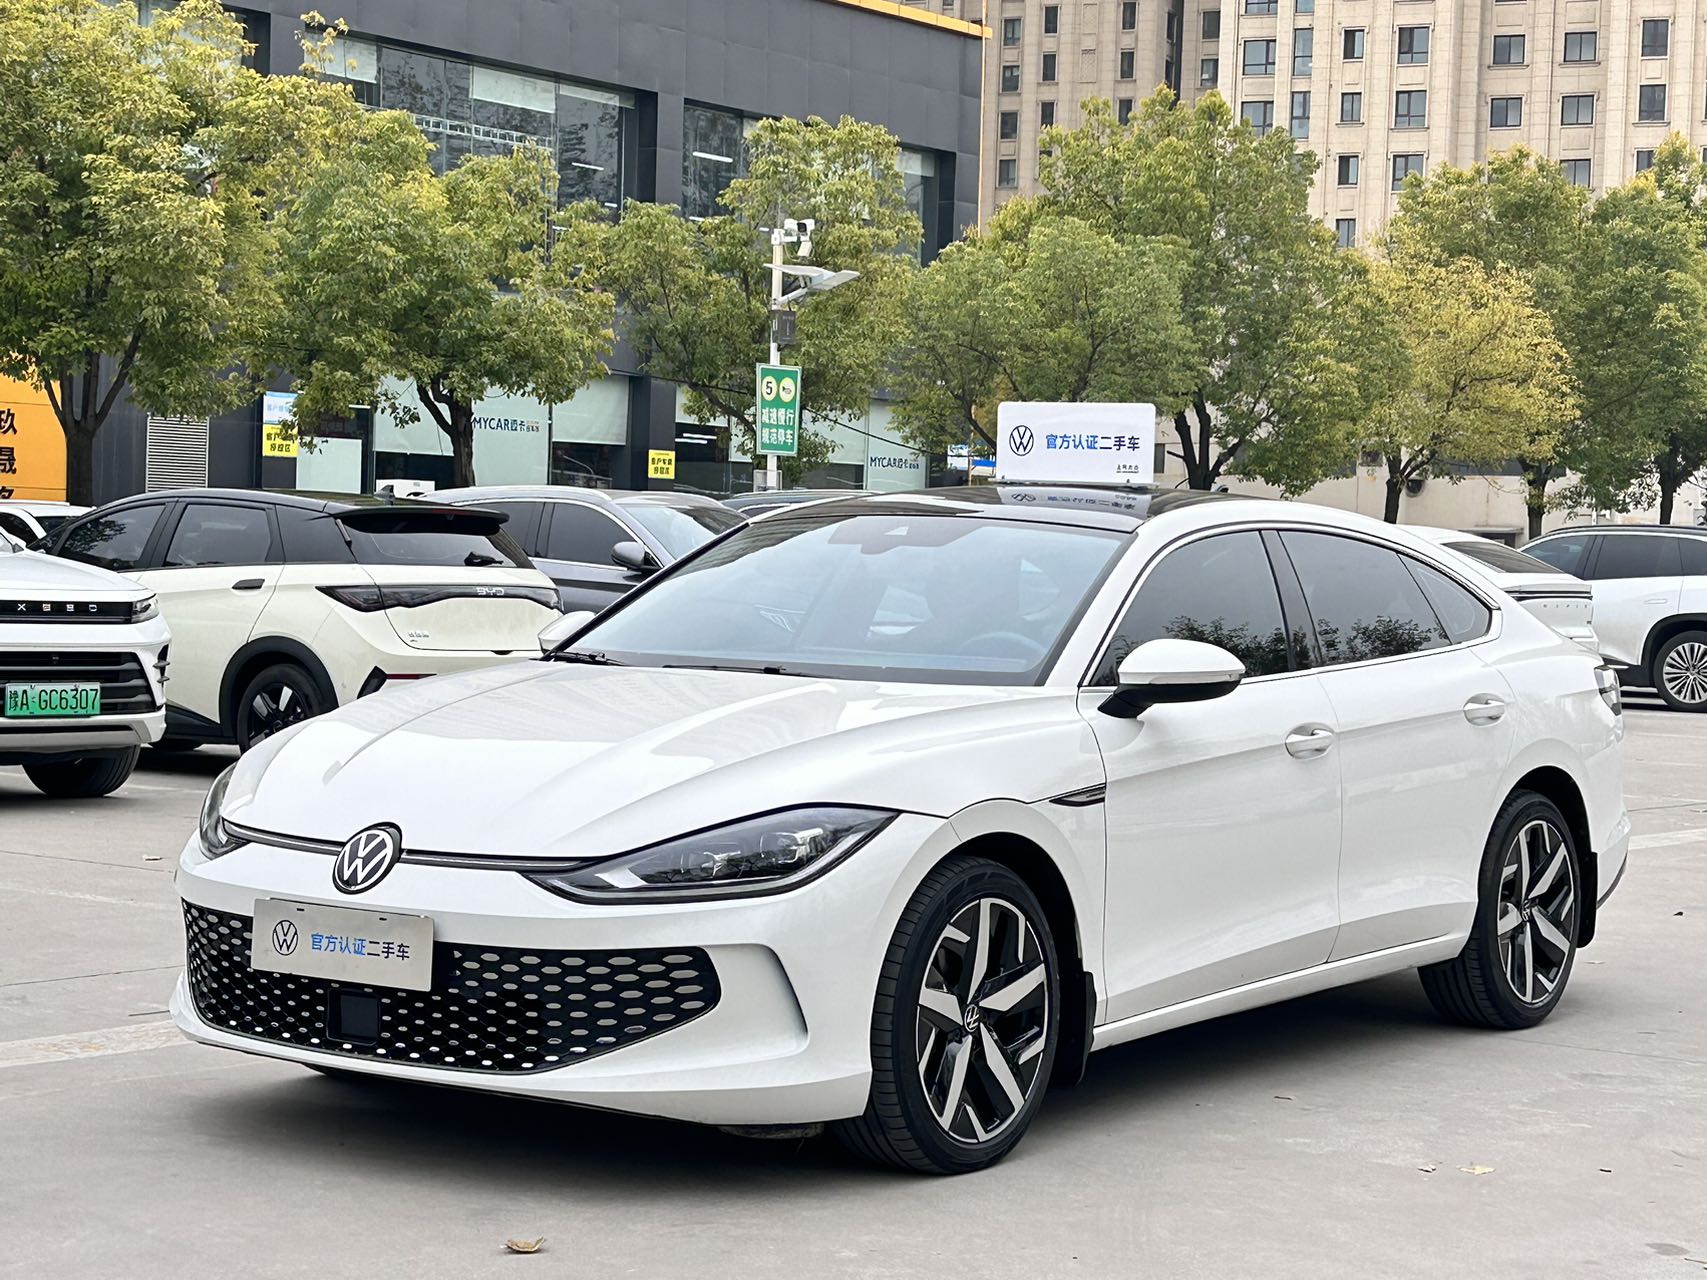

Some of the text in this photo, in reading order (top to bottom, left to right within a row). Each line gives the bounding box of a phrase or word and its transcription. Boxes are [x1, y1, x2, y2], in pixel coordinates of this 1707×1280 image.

[765, 381, 773, 395] 5
[1045, 434, 1141, 452] 官方认证二手车
[476, 586, 505, 597] BYD
[310, 932, 410, 961] 官方认证二手车
